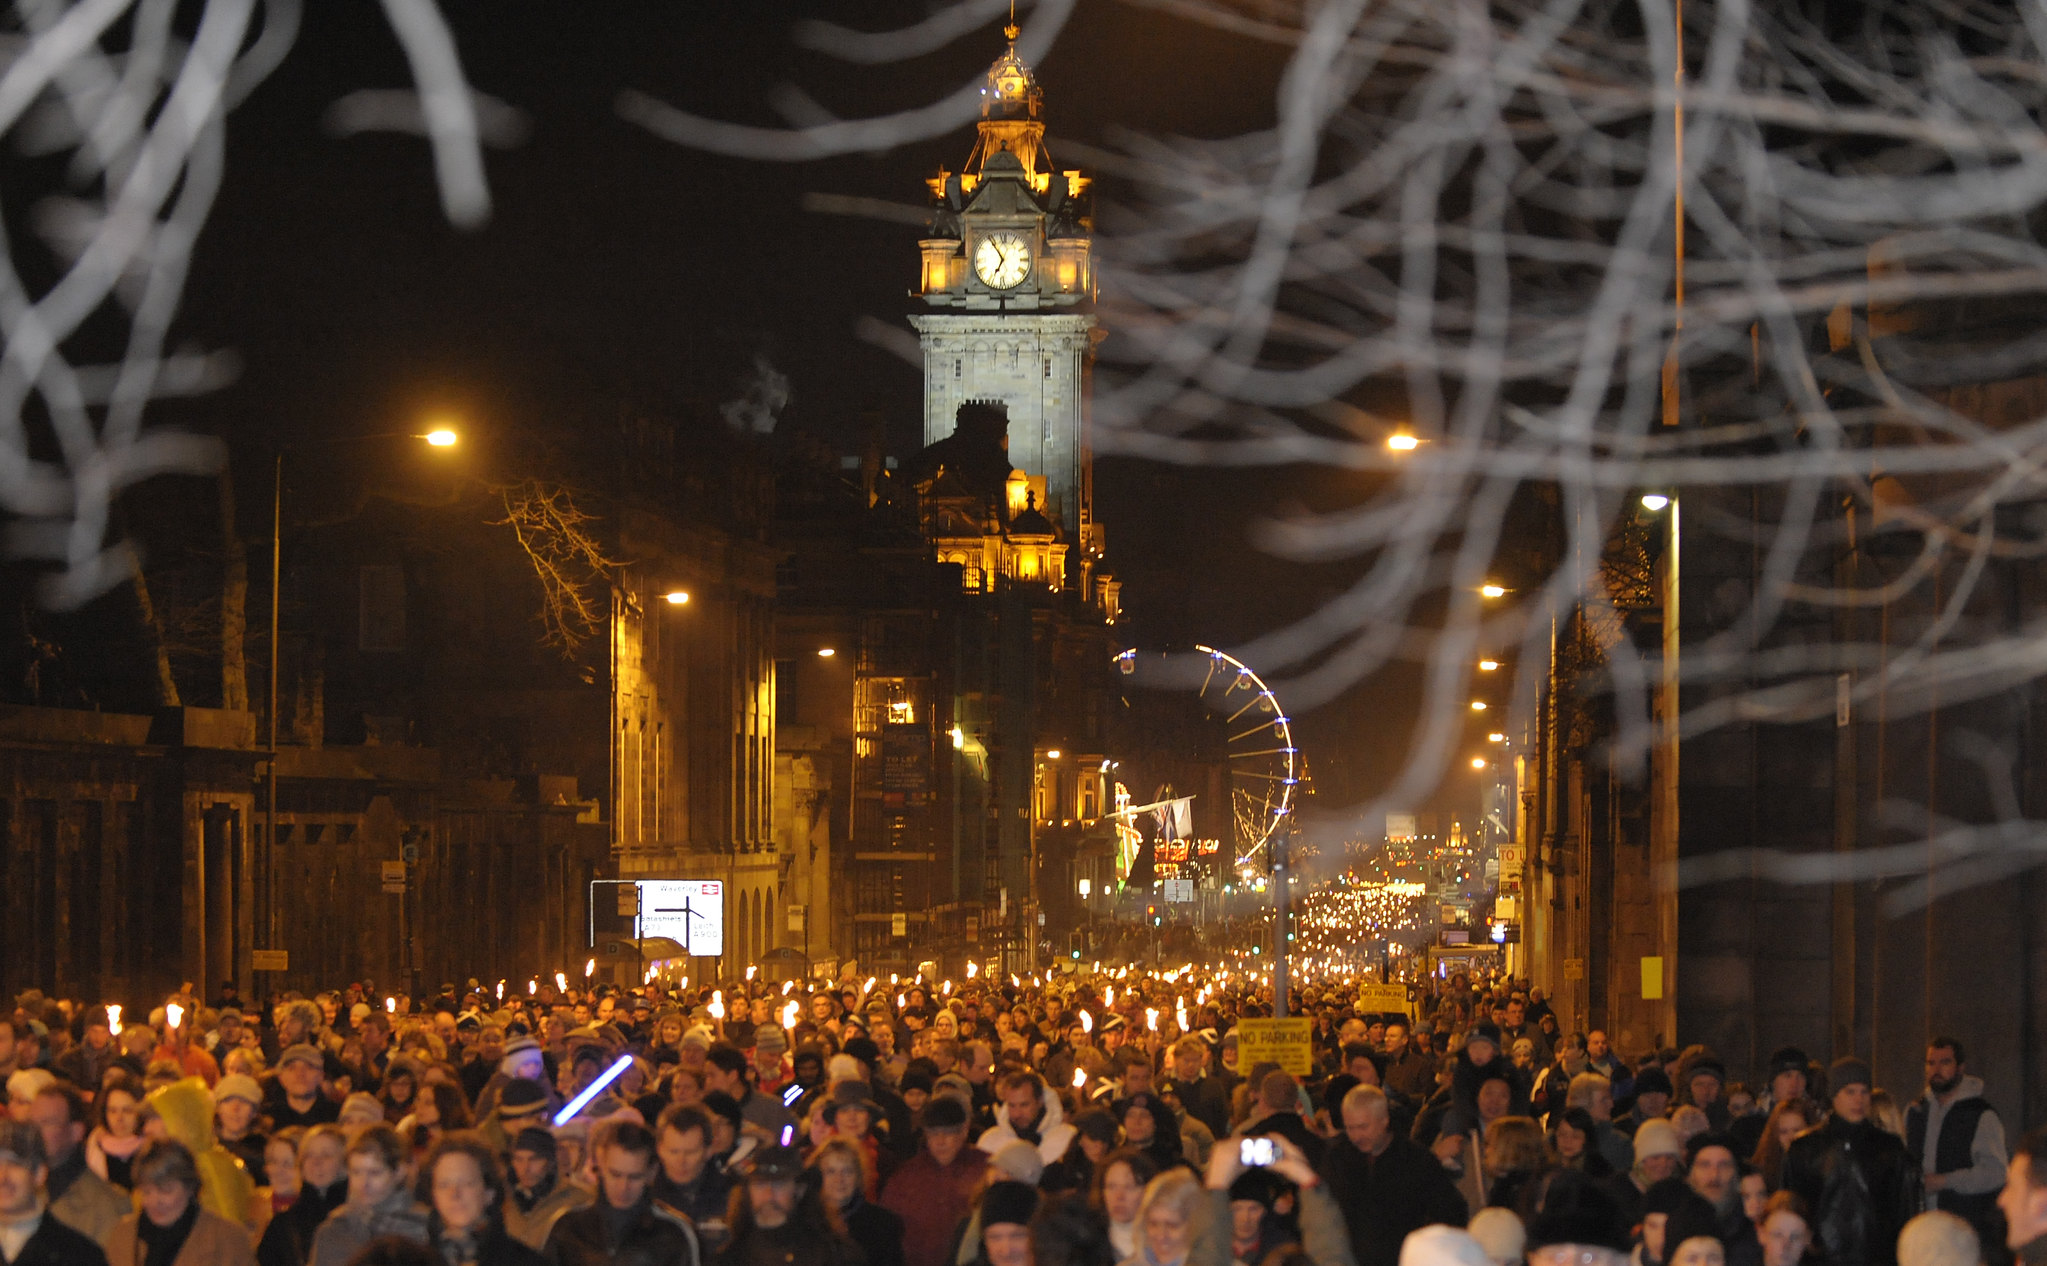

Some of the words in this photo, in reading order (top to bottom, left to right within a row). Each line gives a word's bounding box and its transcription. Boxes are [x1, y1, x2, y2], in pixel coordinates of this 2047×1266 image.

[1499, 849, 1515, 861] TO
[660, 885, 698, 893] Waverley
[1361, 989, 1372, 997] NO
[1374, 989, 1406, 998] PARKING
[1408, 990, 1415, 1000] P
[1239, 1031, 1257, 1045] NO
[1260, 1030, 1309, 1046] PARKING
